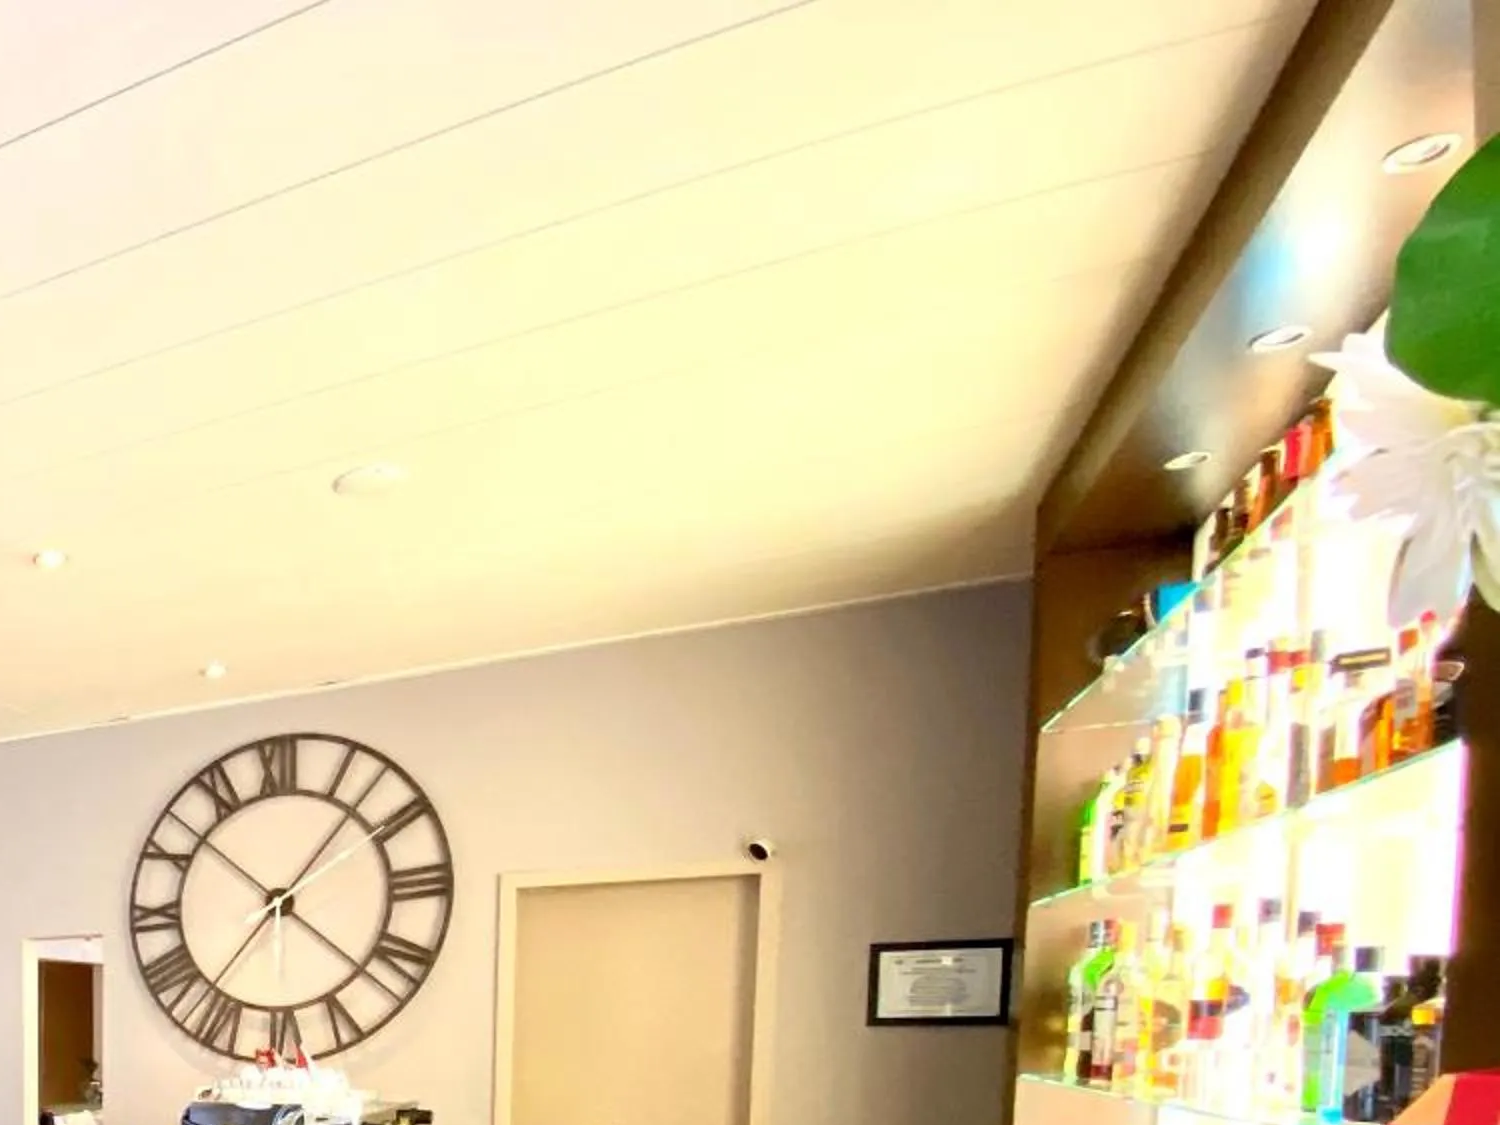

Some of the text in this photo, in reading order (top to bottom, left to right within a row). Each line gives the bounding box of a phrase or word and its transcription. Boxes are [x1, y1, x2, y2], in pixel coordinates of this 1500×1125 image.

[257, 739, 297, 796] XII
[388, 862, 451, 902] III
[131, 902, 182, 933] IX
